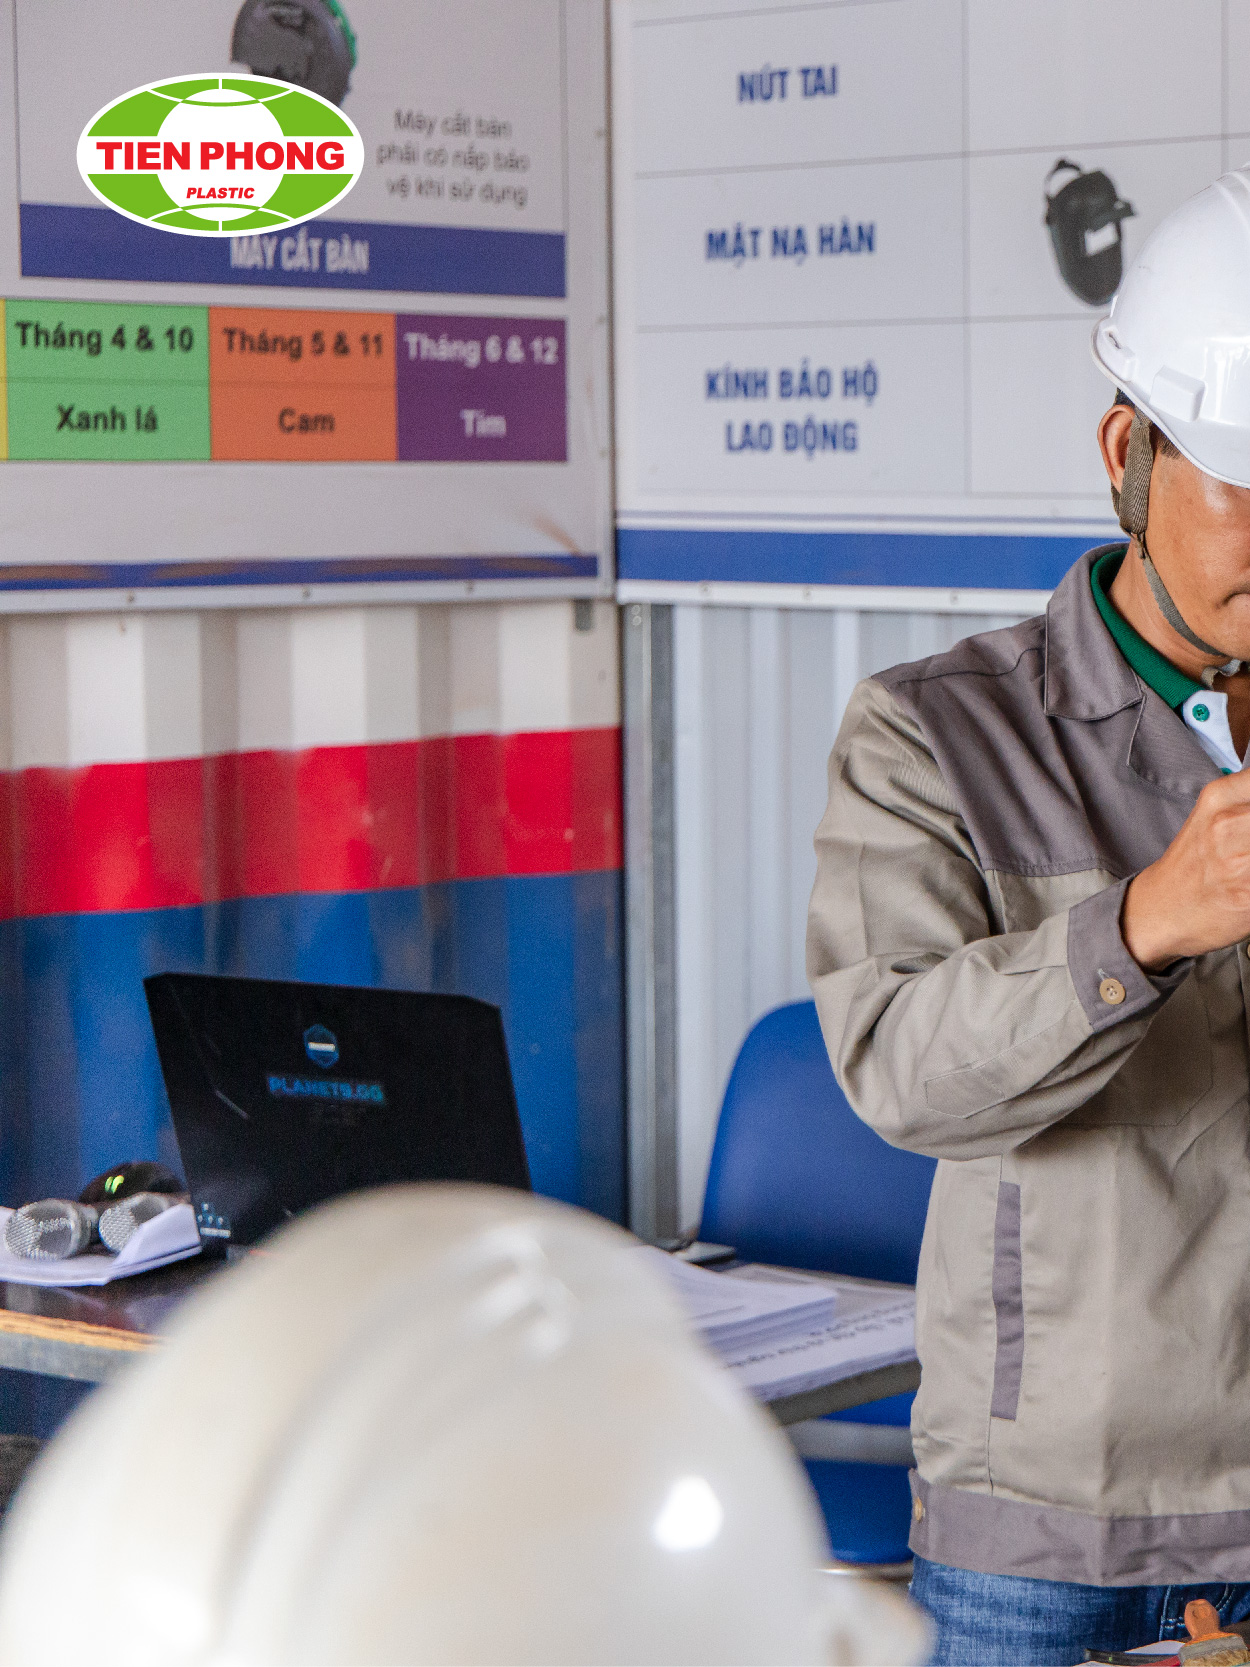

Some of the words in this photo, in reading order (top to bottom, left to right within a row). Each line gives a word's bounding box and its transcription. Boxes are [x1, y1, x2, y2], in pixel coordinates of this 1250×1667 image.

[737, 65, 790, 103] NÚT
[801, 65, 839, 99] TAI
[394, 109, 437, 138] Máy
[326, 233, 369, 274] BÀN
[771, 225, 809, 265] NẠ
[819, 216, 876, 255] HÀN
[15, 321, 103, 357] Tháng
[111, 324, 126, 350] 4
[136, 325, 154, 351] &
[164, 325, 194, 352] 10
[222, 327, 303, 362] Tháng
[312, 330, 326, 355] 5
[333, 331, 349, 357] &
[359, 333, 383, 359] 11
[404, 332, 481, 369] Tháng
[485, 335, 501, 363] 6
[506, 335, 525, 364] &
[533, 337, 558, 365] 12
[705, 363, 769, 401] KÍNH
[779, 357, 832, 400] BẢO
[842, 361, 879, 405] HỘ
[57, 404, 127, 432] Xanh
[136, 405, 158, 432] lá
[278, 407, 335, 434] Cam
[726, 421, 772, 453] LAO
[783, 415, 858, 460] ĐỘNG
